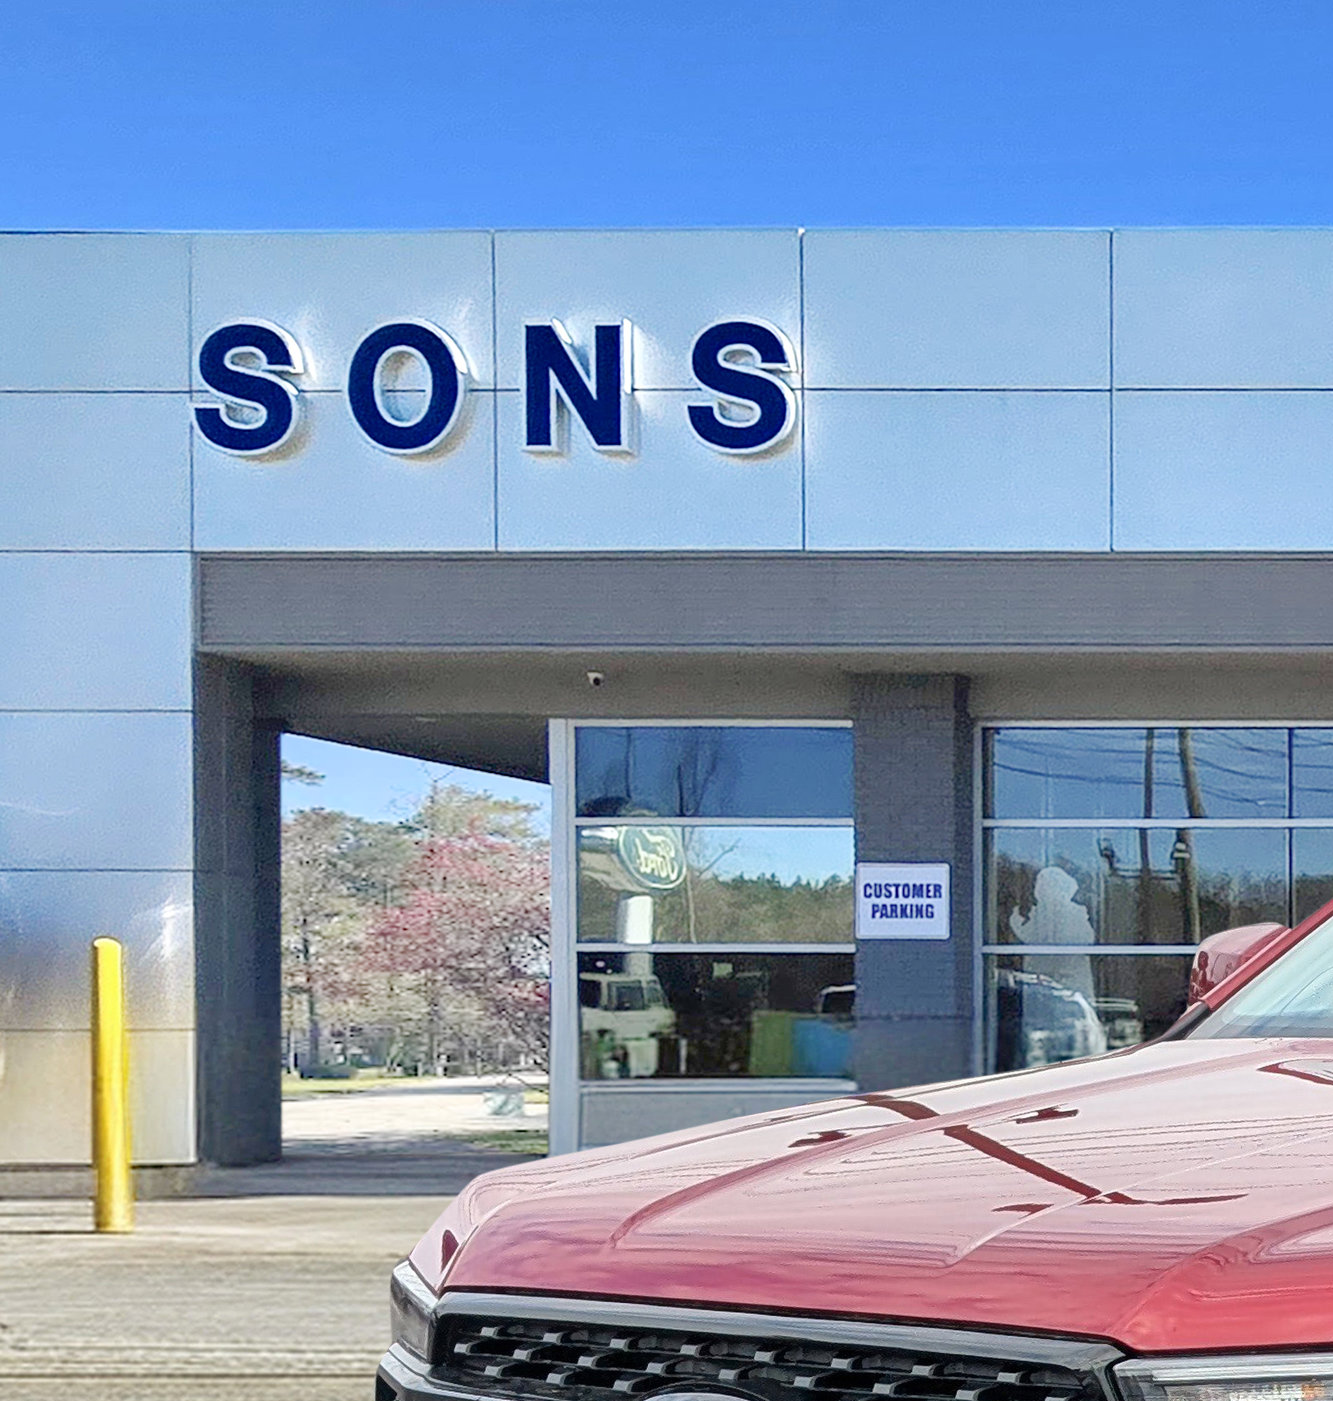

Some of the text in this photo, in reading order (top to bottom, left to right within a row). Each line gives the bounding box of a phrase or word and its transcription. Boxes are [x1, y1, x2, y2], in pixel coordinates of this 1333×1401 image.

[193, 320, 800, 454] SONS
[863, 882, 943, 899] CUSTOMER
[871, 903, 935, 919] PARKING
